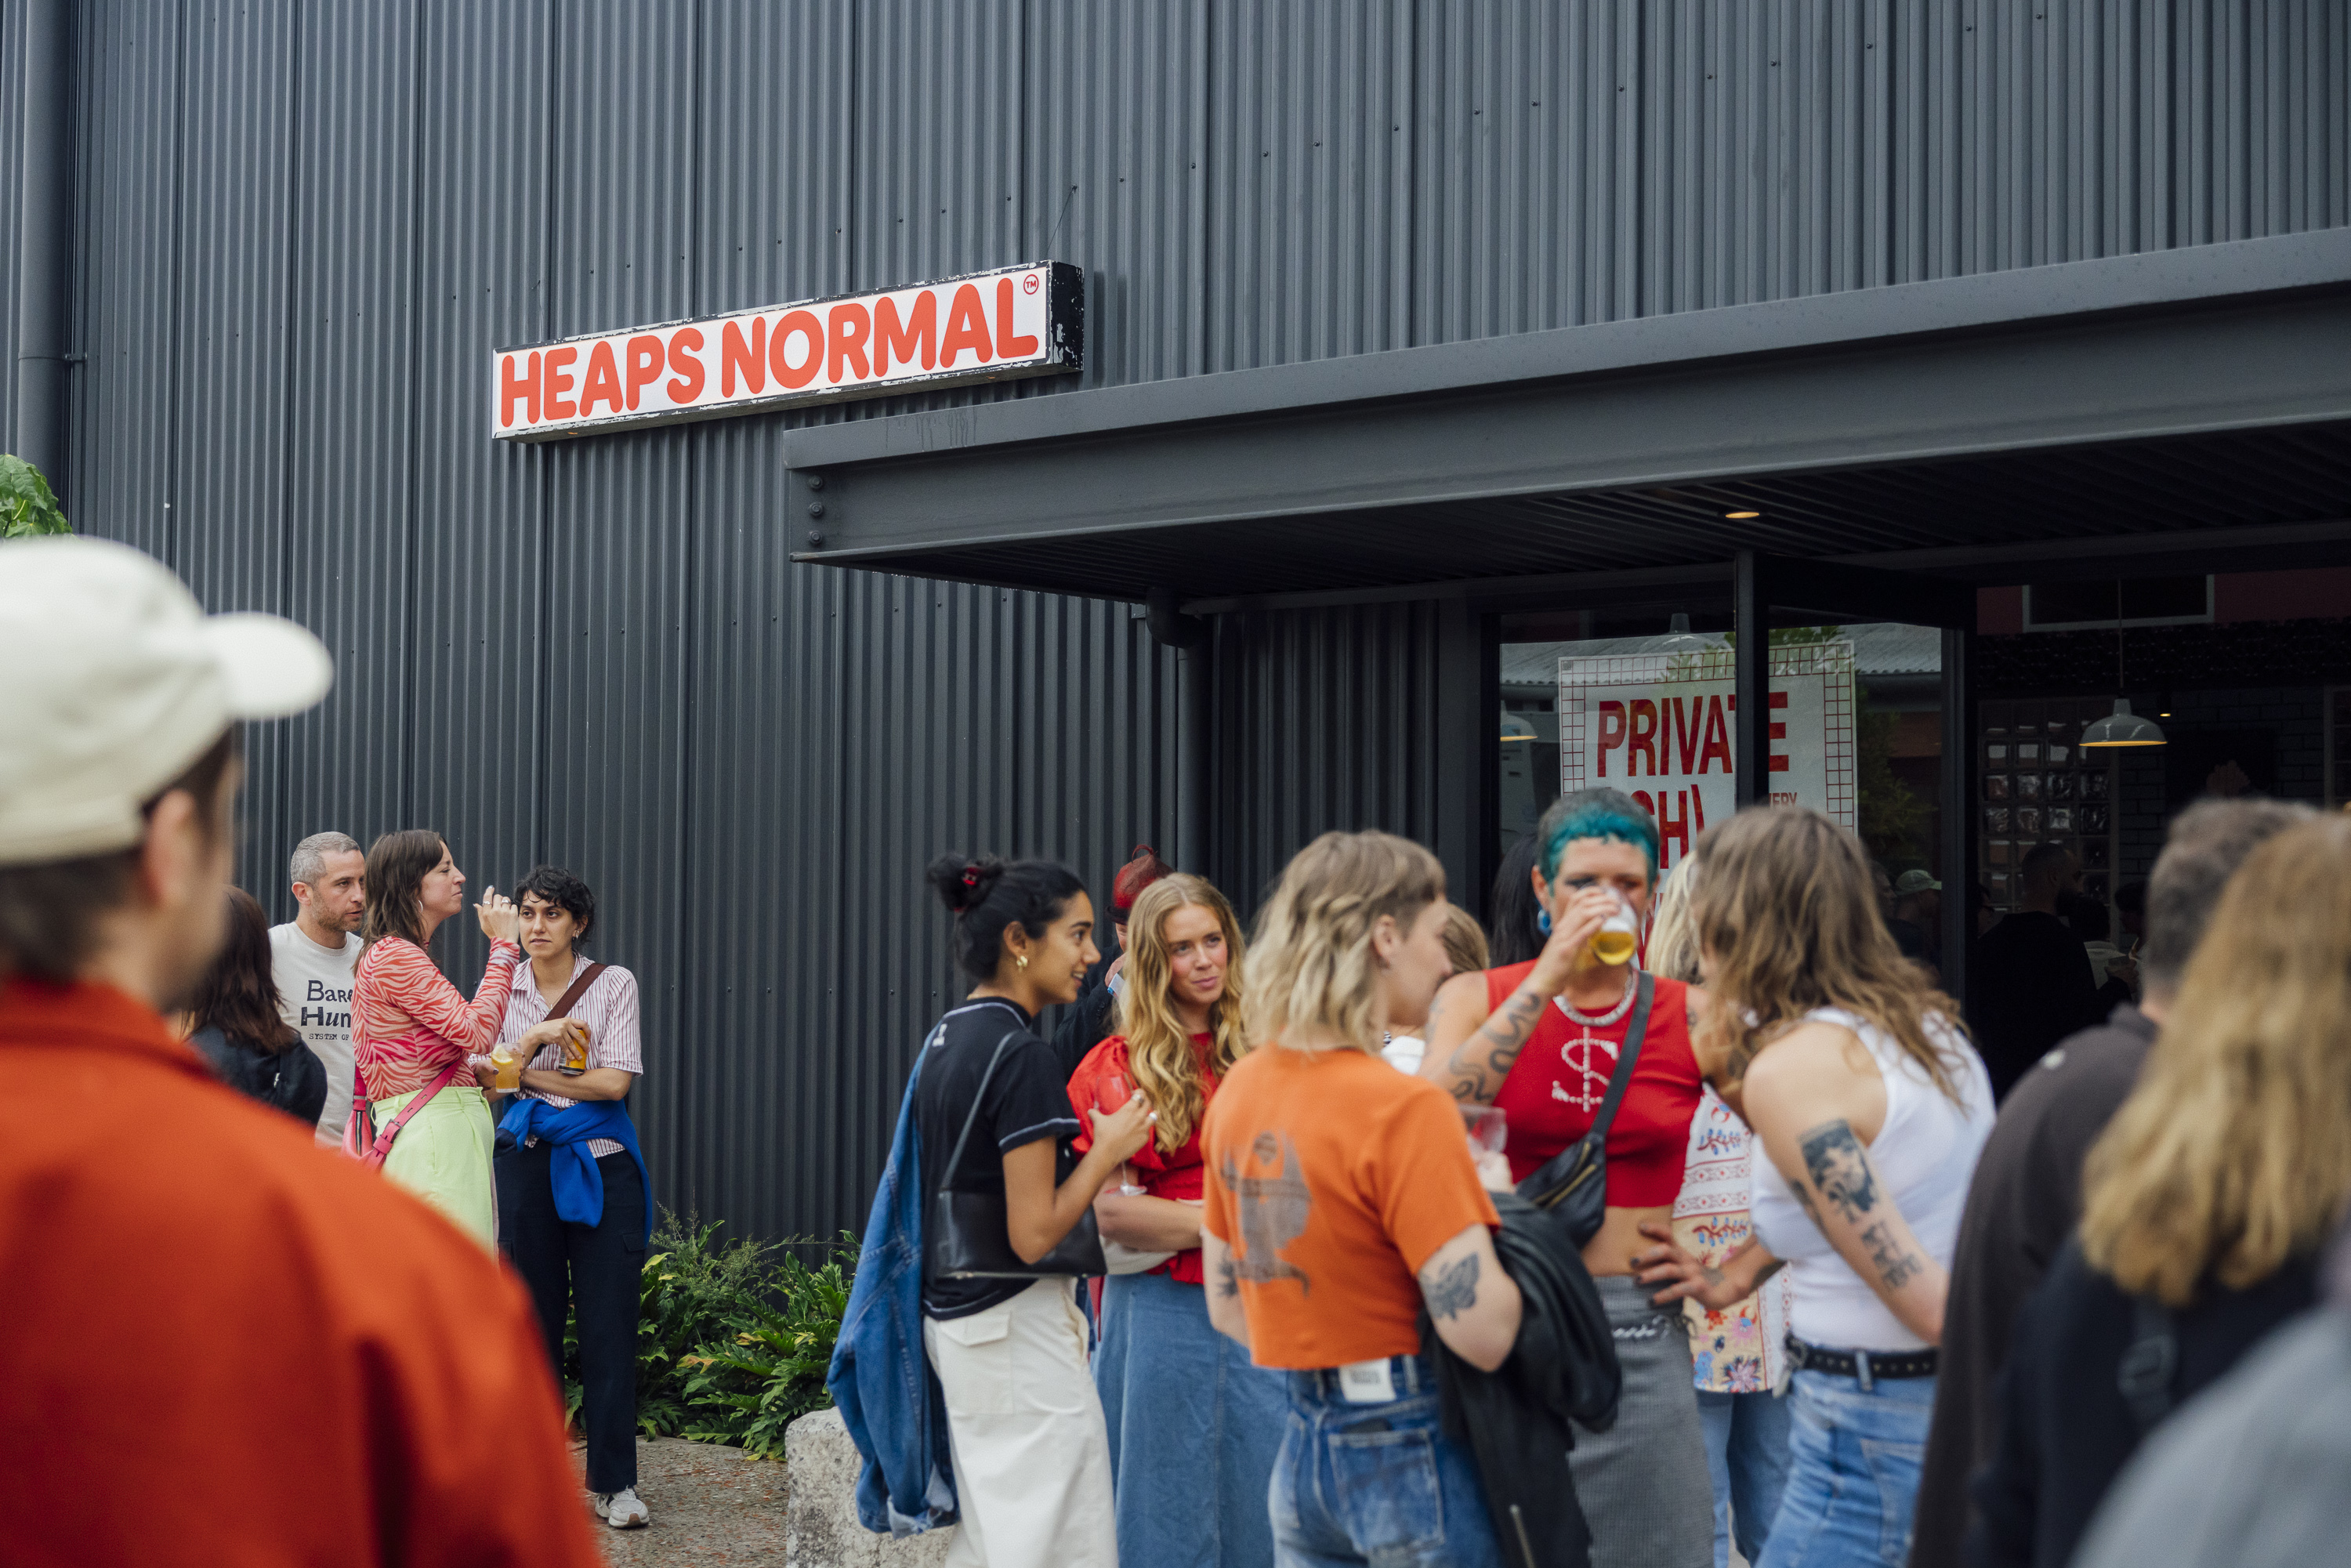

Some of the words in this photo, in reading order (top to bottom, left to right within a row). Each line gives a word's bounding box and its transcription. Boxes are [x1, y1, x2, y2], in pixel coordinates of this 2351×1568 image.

[502, 328, 705, 427] HEAPS
[721, 278, 1038, 398] NORMAL
[1597, 691, 1789, 778] PRIVAE
